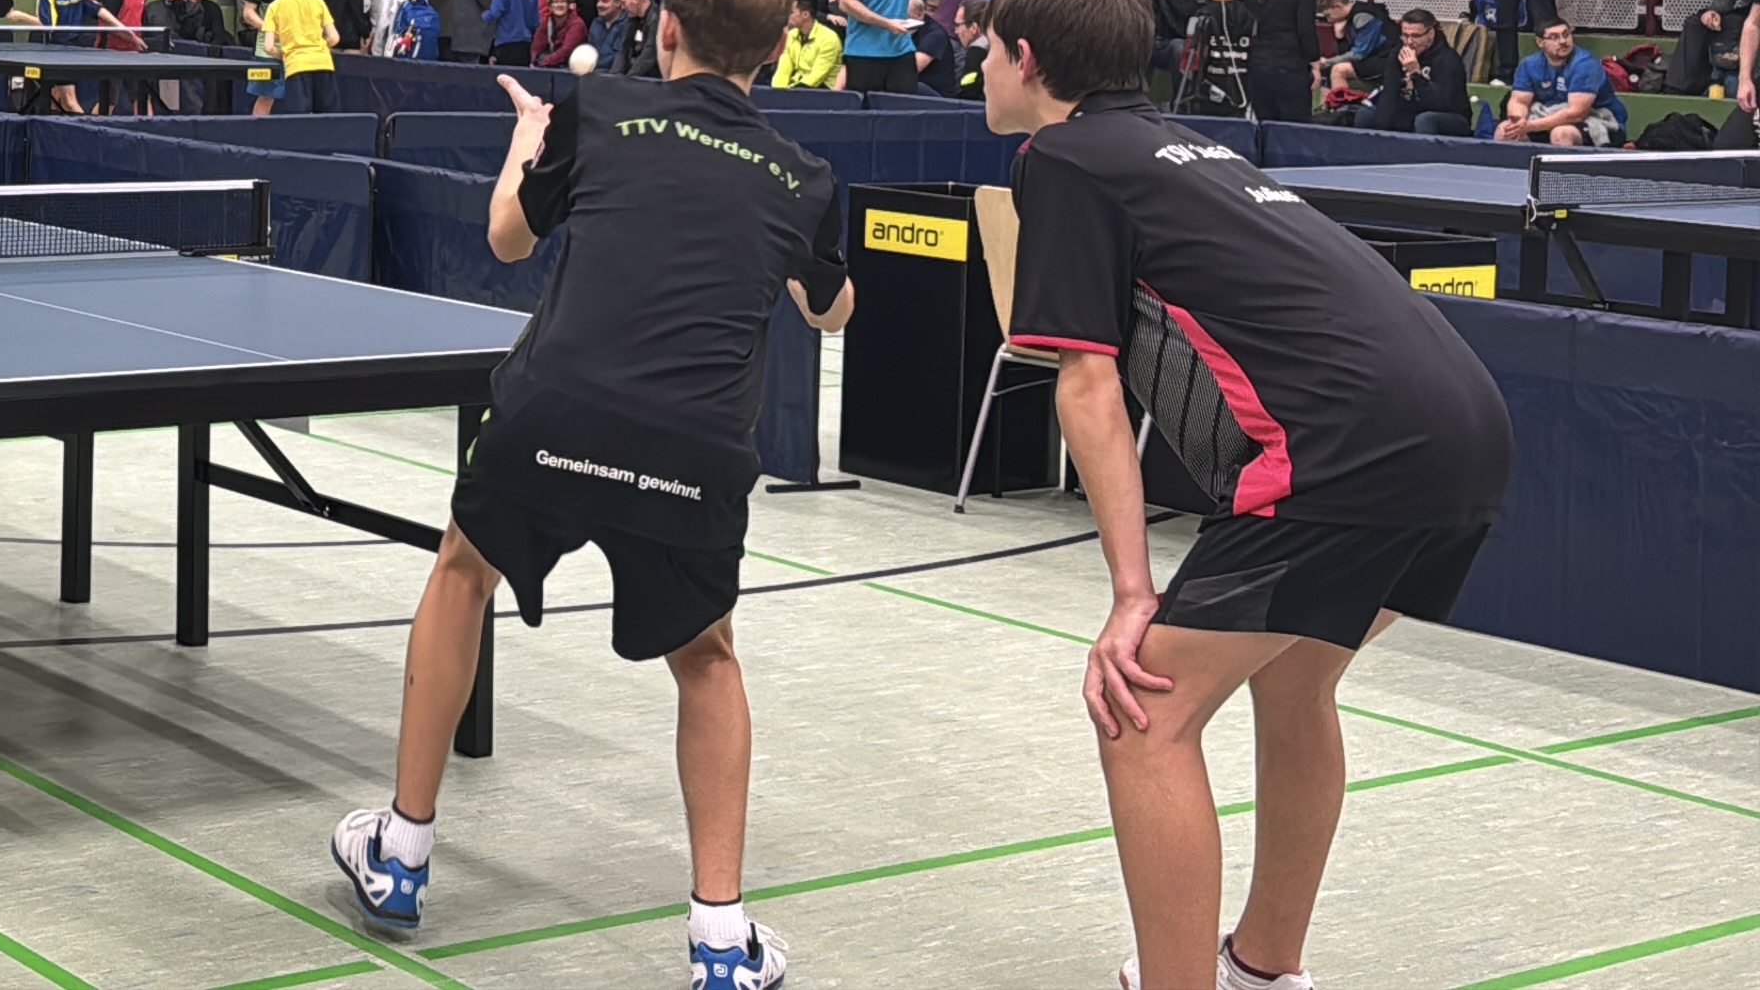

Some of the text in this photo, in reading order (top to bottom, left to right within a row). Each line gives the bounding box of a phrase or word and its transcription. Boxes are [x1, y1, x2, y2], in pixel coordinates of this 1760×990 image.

[615, 118, 801, 198] TTV Werder e.V.
[872, 222, 938, 246] andro
[535, 449, 635, 483] Gemeinsam
